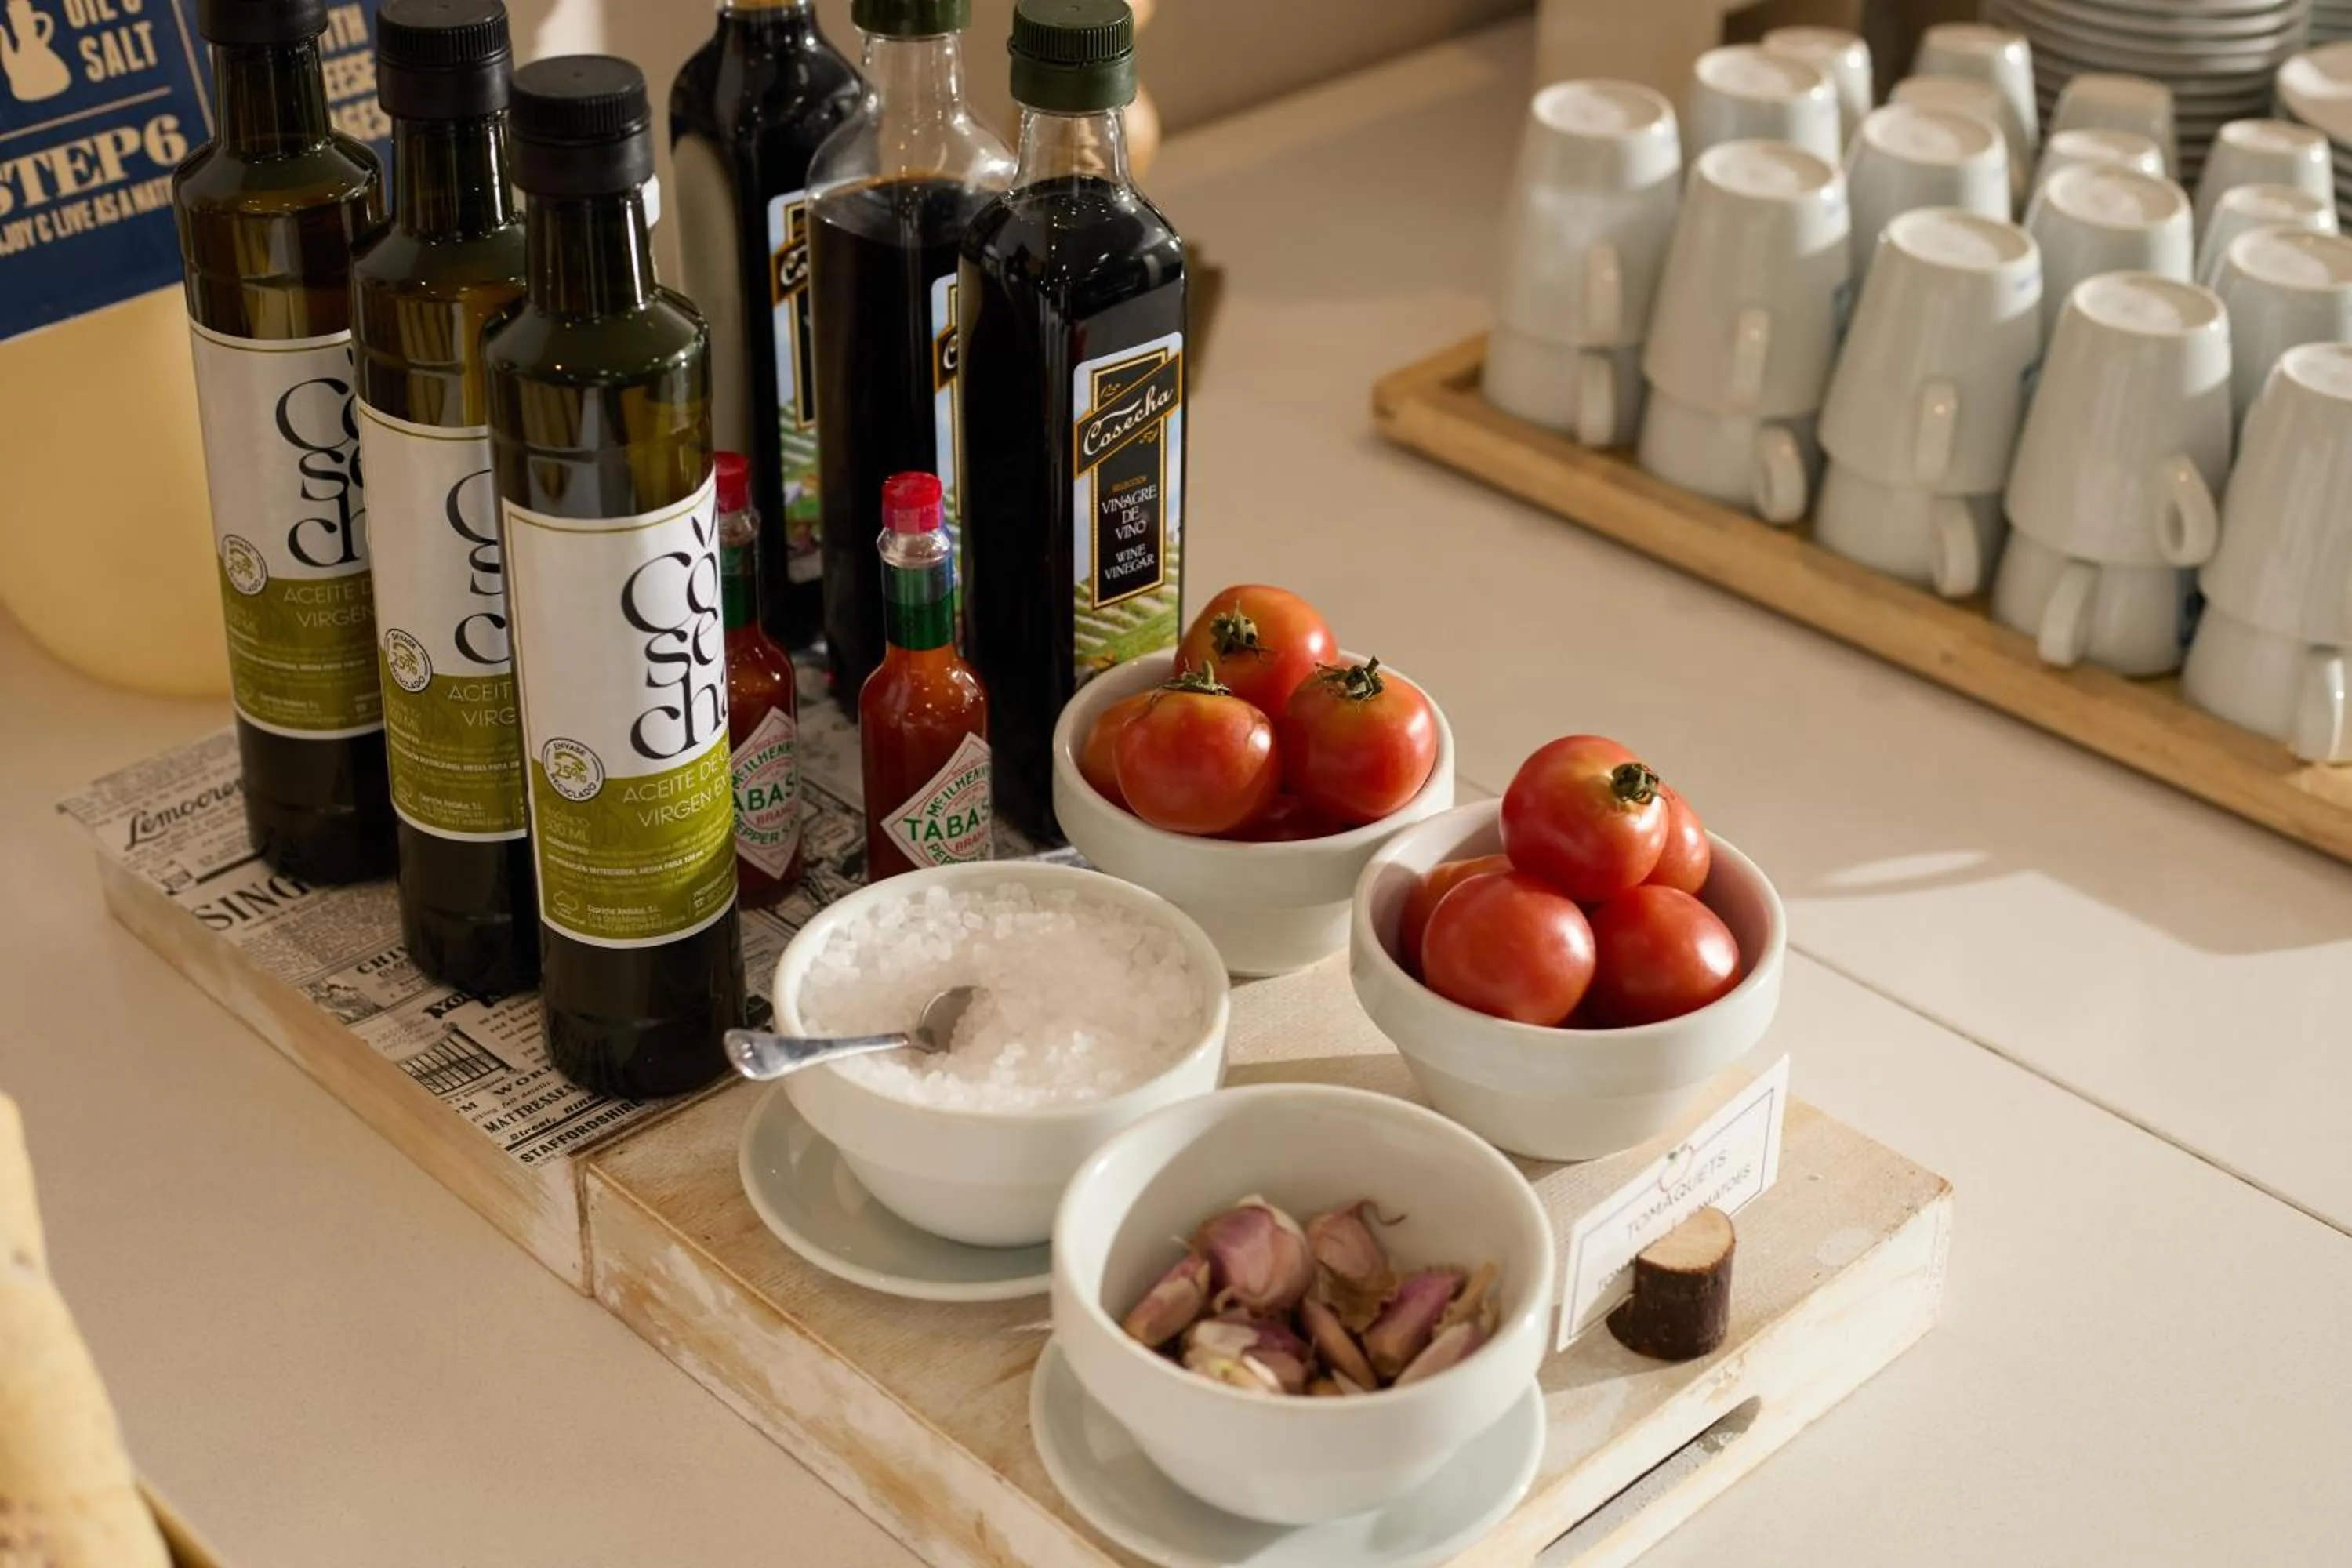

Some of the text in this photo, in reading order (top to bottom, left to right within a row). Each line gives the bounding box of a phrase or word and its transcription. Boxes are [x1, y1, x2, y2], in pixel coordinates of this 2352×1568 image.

[78, 20, 158, 82] SALT
[50, 199, 96, 239] LIVE
[1083, 385, 1174, 455] Cosecha
[1102, 484, 1157, 514] VINAGRE
[1122, 506, 1139, 524] DE
[1116, 519, 1147, 540] VINO
[1104, 553, 1155, 580] VINEGAR
[1116, 543, 1146, 563] WINE
[283, 582, 354, 604] ACEITE
[448, 681, 512, 703] ACEIT
[461, 706, 515, 728] VIRG
[554, 762, 587, 783] 25%
[623, 768, 695, 804] ACEITE
[700, 752, 719, 782] DE
[637, 787, 713, 827] VIRGEN
[902, 795, 990, 841] TABAS
[955, 828, 985, 851] BRAN
[483, 1082, 579, 1134] MATTRESSES
[519, 1098, 645, 1163] STAFFORDSHIRE
